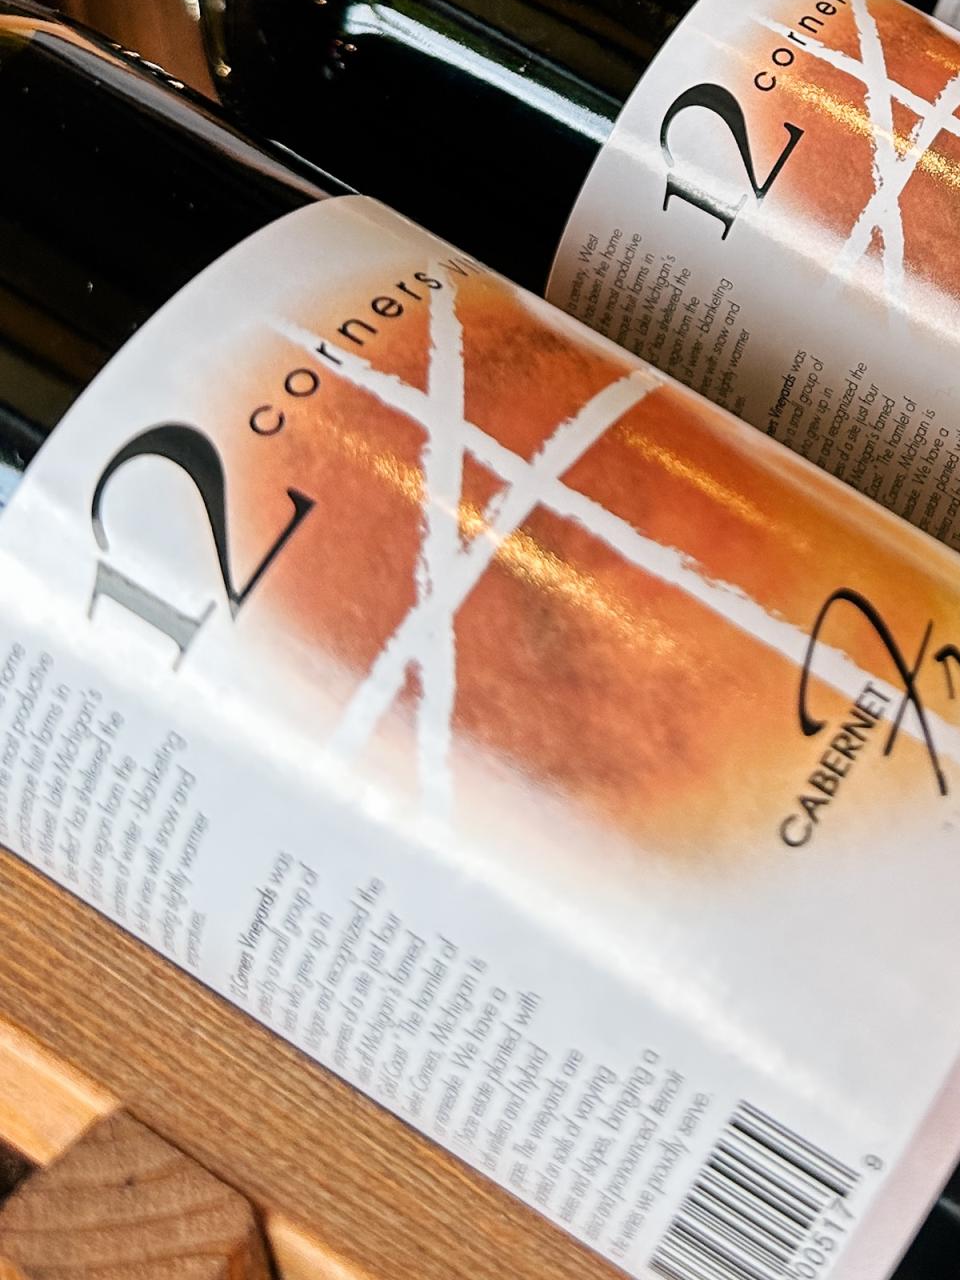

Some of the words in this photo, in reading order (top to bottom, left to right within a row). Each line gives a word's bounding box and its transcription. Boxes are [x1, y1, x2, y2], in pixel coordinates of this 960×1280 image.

[660, 83, 805, 241] 12
[578, 233, 599, 263] West
[598, 229, 623, 261] home
[614, 233, 642, 291] productive
[593, 261, 610, 278] the
[627, 266, 650, 295] farms
[644, 253, 655, 265] in
[642, 255, 676, 313] Michigan's
[658, 282, 683, 332] sheltered
[673, 268, 691, 286] the
[682, 297, 700, 314] the
[697, 278, 734, 334] blanketing
[672, 315, 693, 338] from
[713, 326, 729, 355] snow
[724, 300, 740, 326] and
[248, 268, 443, 438] corners
[730, 328, 750, 367] warmer
[768, 373, 797, 418] Vineyards
[790, 350, 807, 372] was
[799, 372, 820, 406] group
[810, 355, 824, 372] of
[820, 387, 834, 399] in
[858, 383, 879, 406] four
[817, 399, 831, 414] up
[818, 434, 834, 456] and
[828, 378, 861, 436] recognized
[849, 362, 867, 380] the
[852, 405, 871, 427] just
[869, 394, 896, 432] famed
[903, 395, 917, 412] of
[806, 413, 822, 441] grew
[844, 442, 854, 451] a
[847, 424, 862, 443] site
[884, 412, 911, 448] hamlet
[898, 421, 930, 468] Michigan
[922, 409, 936, 420] is
[939, 427, 949, 437] a
[876, 448, 895, 466] The
[920, 438, 944, 465] have
[912, 465, 931, 485] We
[89, 421, 317, 673] 12
[11, 652, 54, 739] productive
[52, 684, 71, 703] in
[52, 689, 102, 777] Michigan's
[97, 712, 124, 739] the
[112, 756, 136, 782] the
[129, 730, 187, 815] blanketing
[780, 680, 892, 848] CABERNET
[171, 764, 196, 806] and
[180, 812, 207, 868] warmer
[238, 888, 277, 949] Vineyards
[269, 852, 293, 885] was
[282, 887, 312, 937] group
[299, 861, 318, 887] of
[308, 929, 328, 951] up
[314, 912, 333, 929] in
[325, 900, 372, 987] recognized
[357, 878, 380, 905] the
[369, 913, 401, 945] four
[362, 942, 388, 976] just
[385, 929, 426, 986] famed
[438, 934, 458, 960] of
[408, 958, 448, 1012] hamlet
[429, 974, 478, 1046] Michigan
[467, 959, 487, 973] is
[492, 987, 507, 1002] a
[395, 1012, 423, 1036] The
[463, 1003, 498, 1042] have
[482, 1022, 522, 1090] planted
[514, 991, 541, 1026] with
[451, 1042, 478, 1070] We
[509, 1041, 549, 1094] hybrid
[562, 1050, 583, 1077] are
[562, 1115, 582, 1138] of
[574, 1065, 617, 1120] varying
[597, 1066, 655, 1132] bringing
[643, 1049, 659, 1065] a
[603, 1112, 659, 1202] pronounced
[646, 1136, 690, 1195] proudly
[863, 1154, 884, 1171] 9
